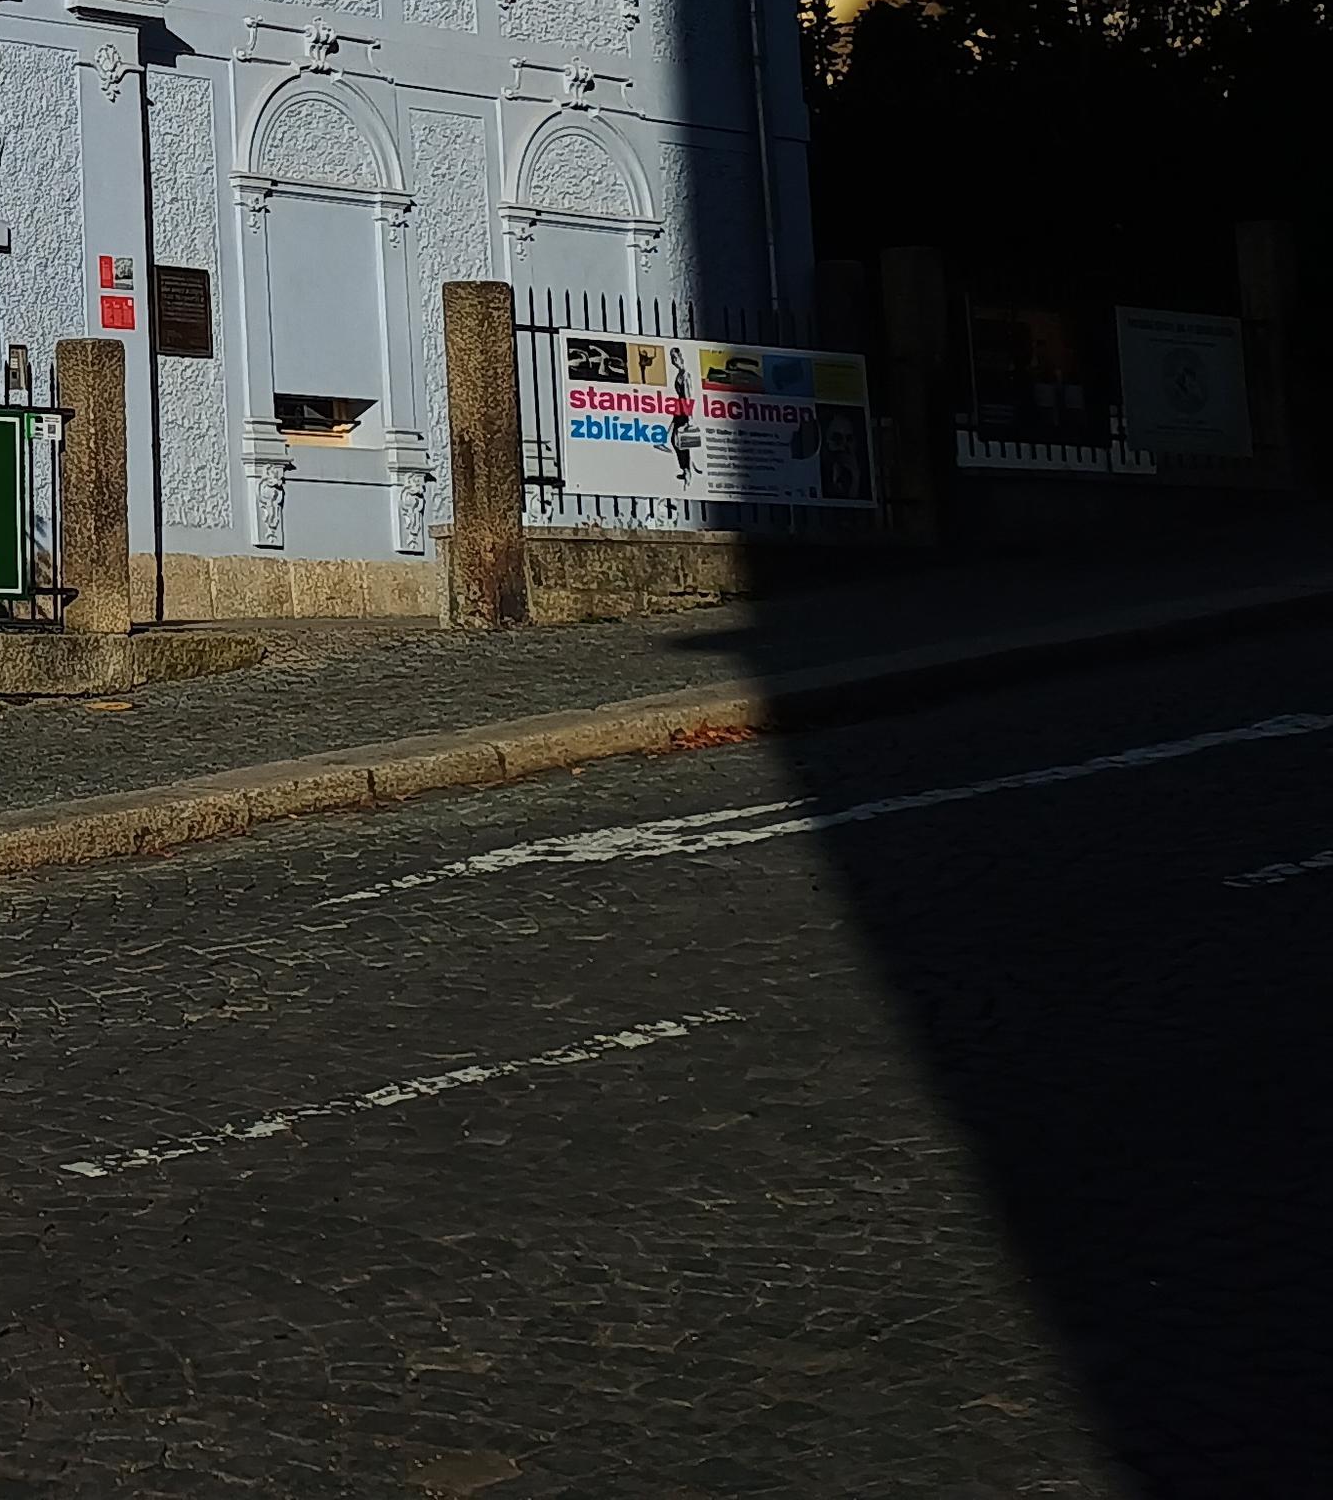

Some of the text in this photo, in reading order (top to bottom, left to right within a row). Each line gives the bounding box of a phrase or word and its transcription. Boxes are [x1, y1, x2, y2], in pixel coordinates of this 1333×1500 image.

[569, 386, 815, 423] stanislav lachman
[570, 414, 669, 444] zblízka
